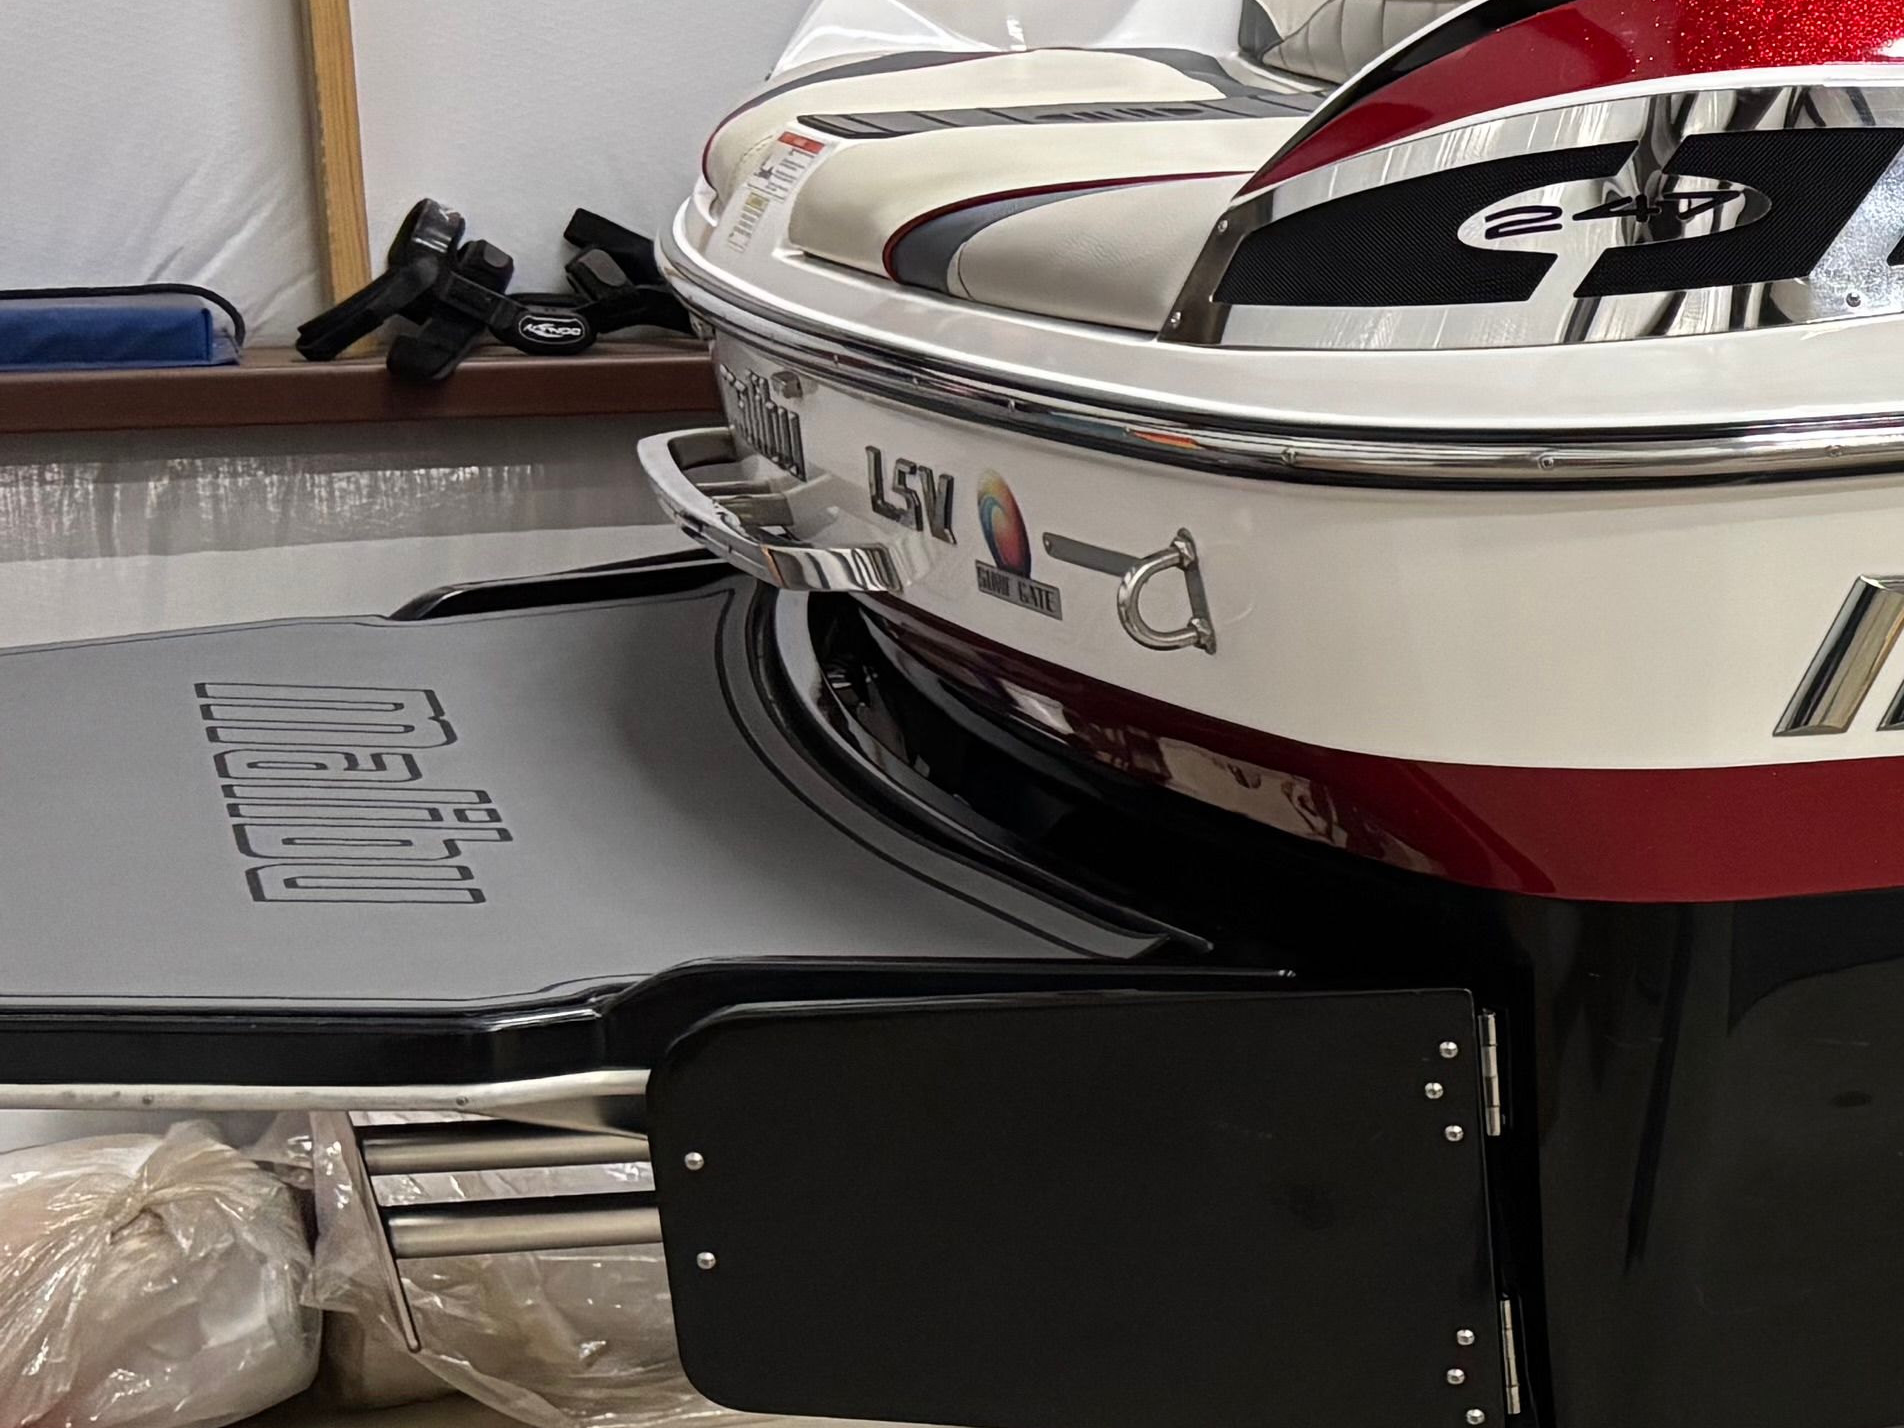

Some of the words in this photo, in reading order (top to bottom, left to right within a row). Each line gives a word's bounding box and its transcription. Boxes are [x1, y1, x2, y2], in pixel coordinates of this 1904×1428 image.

[865, 445, 957, 545] LSV
[1017, 580, 1055, 613] GATE
[194, 682, 514, 905] malibu
